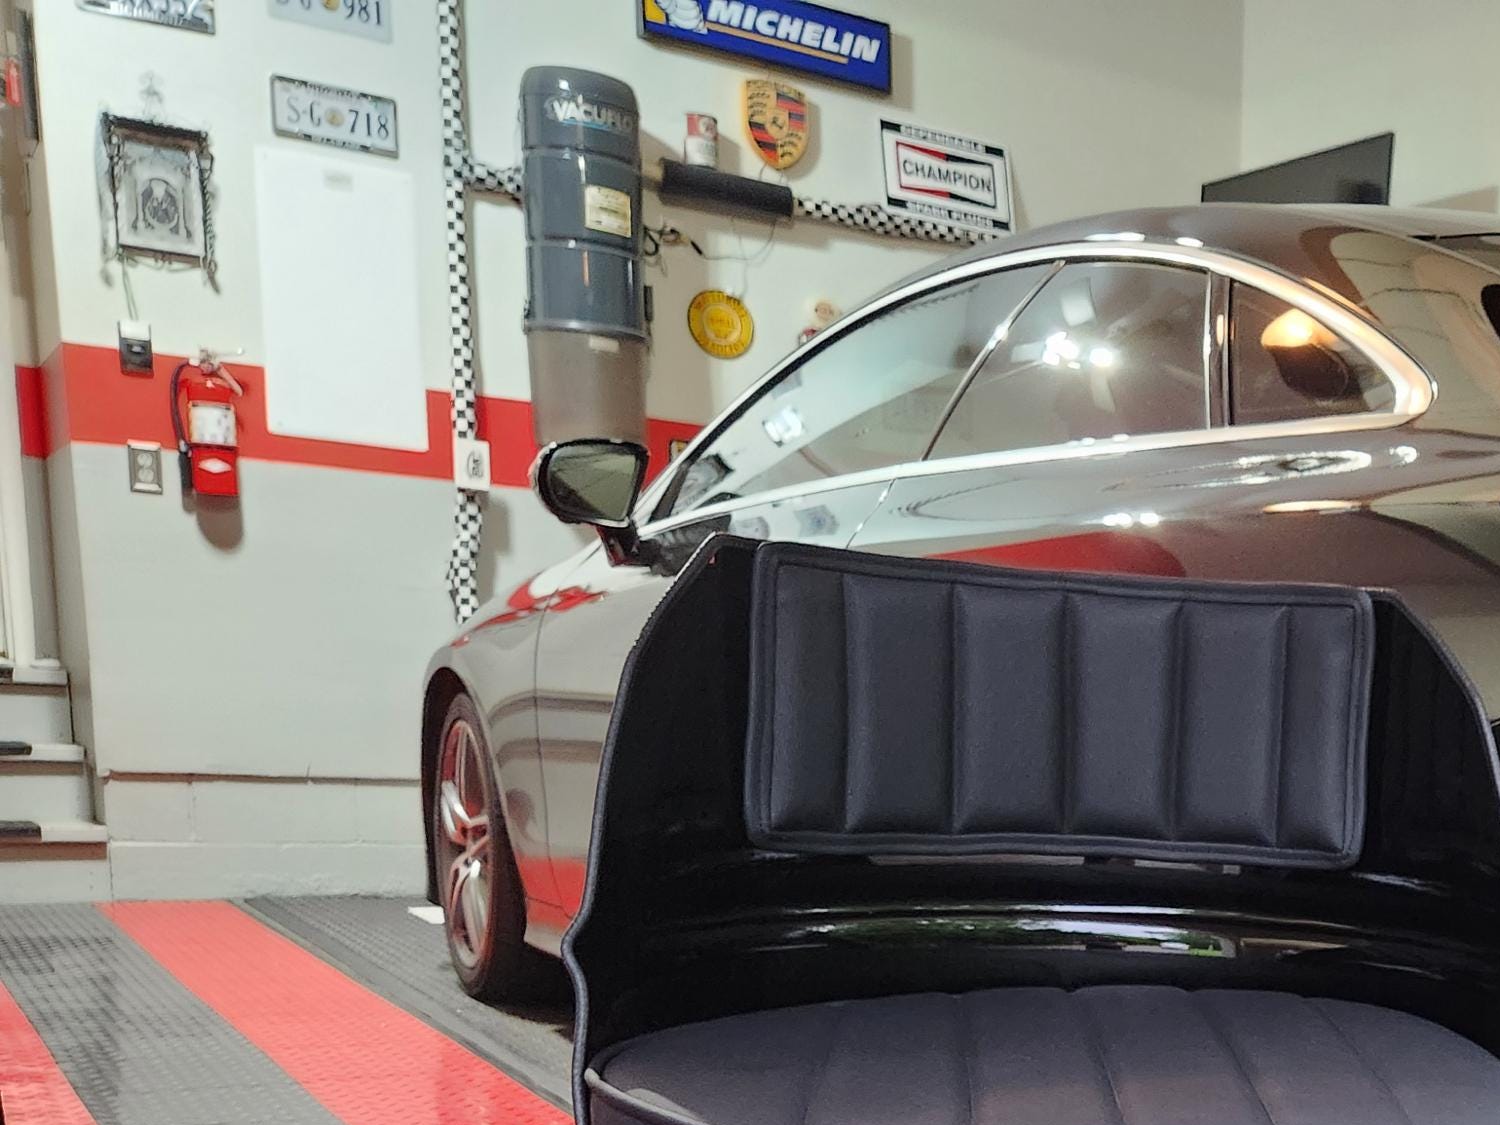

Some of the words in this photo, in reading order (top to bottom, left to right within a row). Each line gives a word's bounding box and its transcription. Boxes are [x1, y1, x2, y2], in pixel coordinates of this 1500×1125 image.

[706, 0, 881, 63] MICHELIN
[348, 107, 390, 141] 718
[902, 159, 993, 193] CHAMPION
